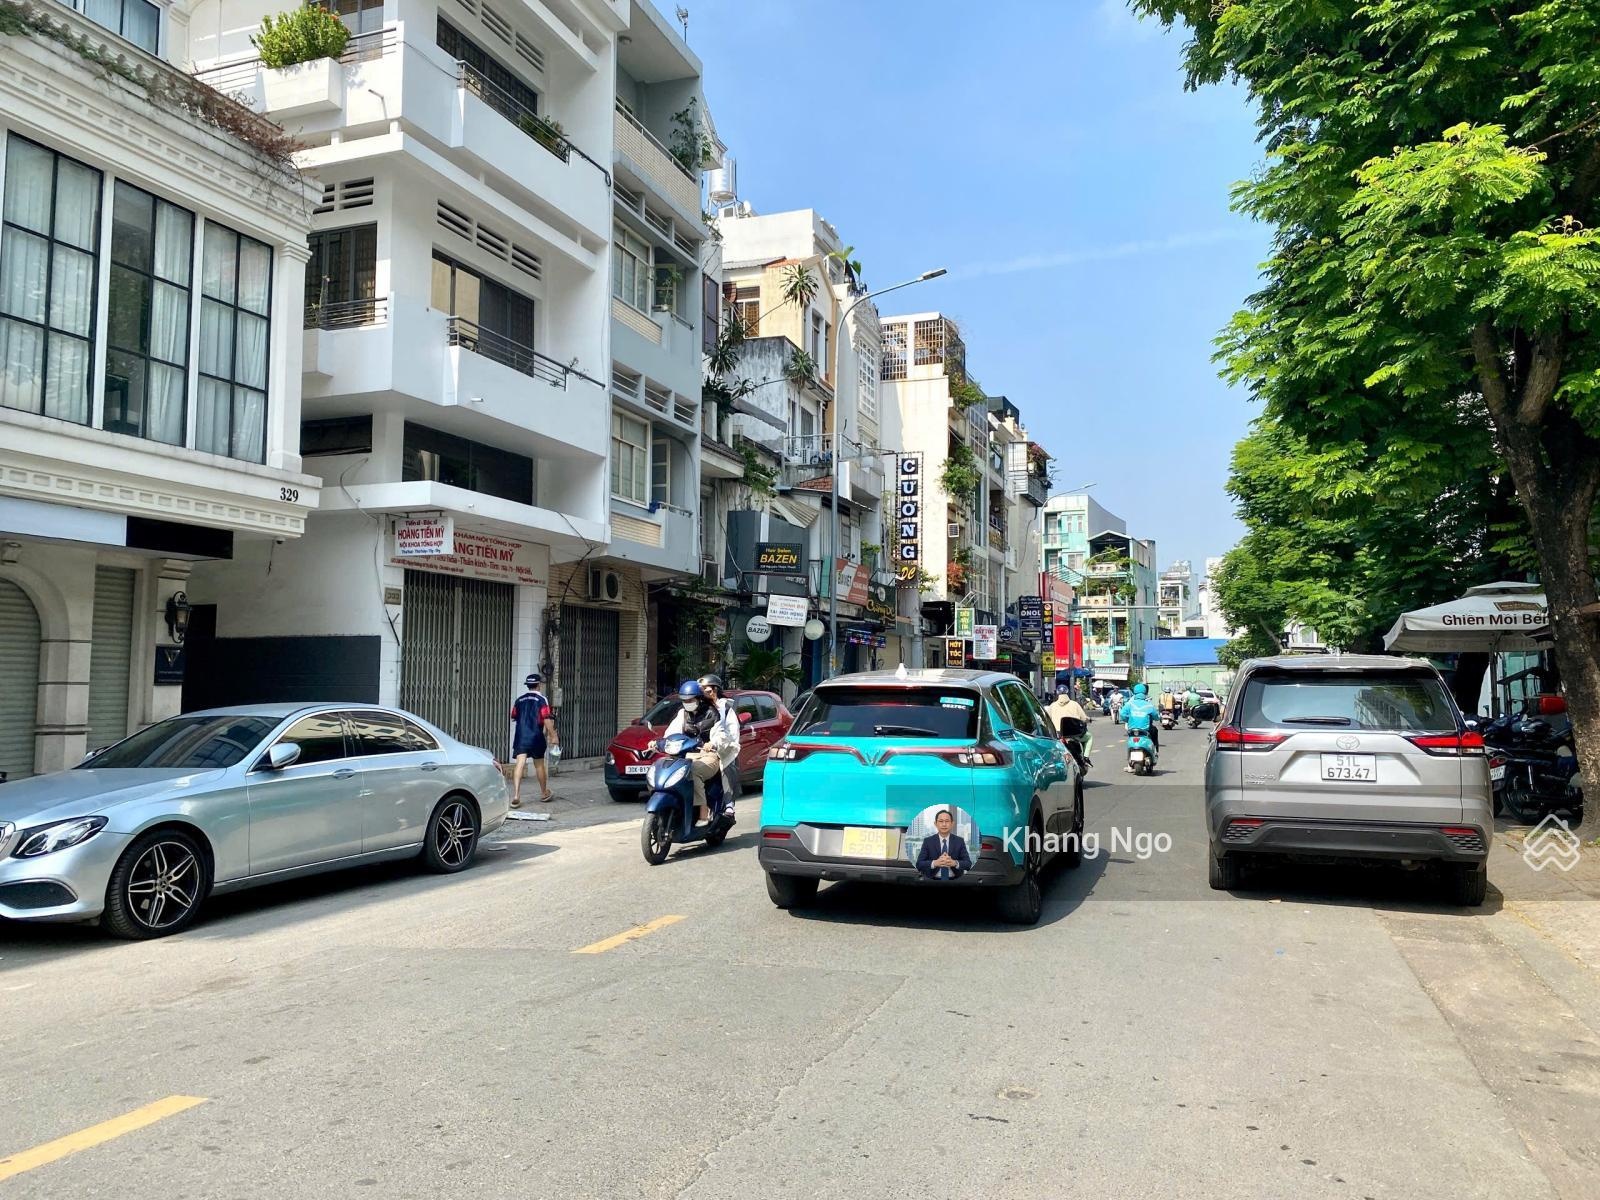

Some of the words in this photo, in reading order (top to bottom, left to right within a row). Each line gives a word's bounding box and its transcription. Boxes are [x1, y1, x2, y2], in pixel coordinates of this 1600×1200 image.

[280, 487, 299, 503] 329
[397, 528, 420, 540] HOÀNG
[420, 526, 434, 539] TIẾN
[475, 544, 497, 559] TIẾN
[760, 554, 797, 564] BAZEN
[901, 566, 916, 580] DC
[747, 627, 769, 635] BAZEN
[1336, 755, 1361, 767] 51L
[1327, 767, 1370, 779] 673.47
